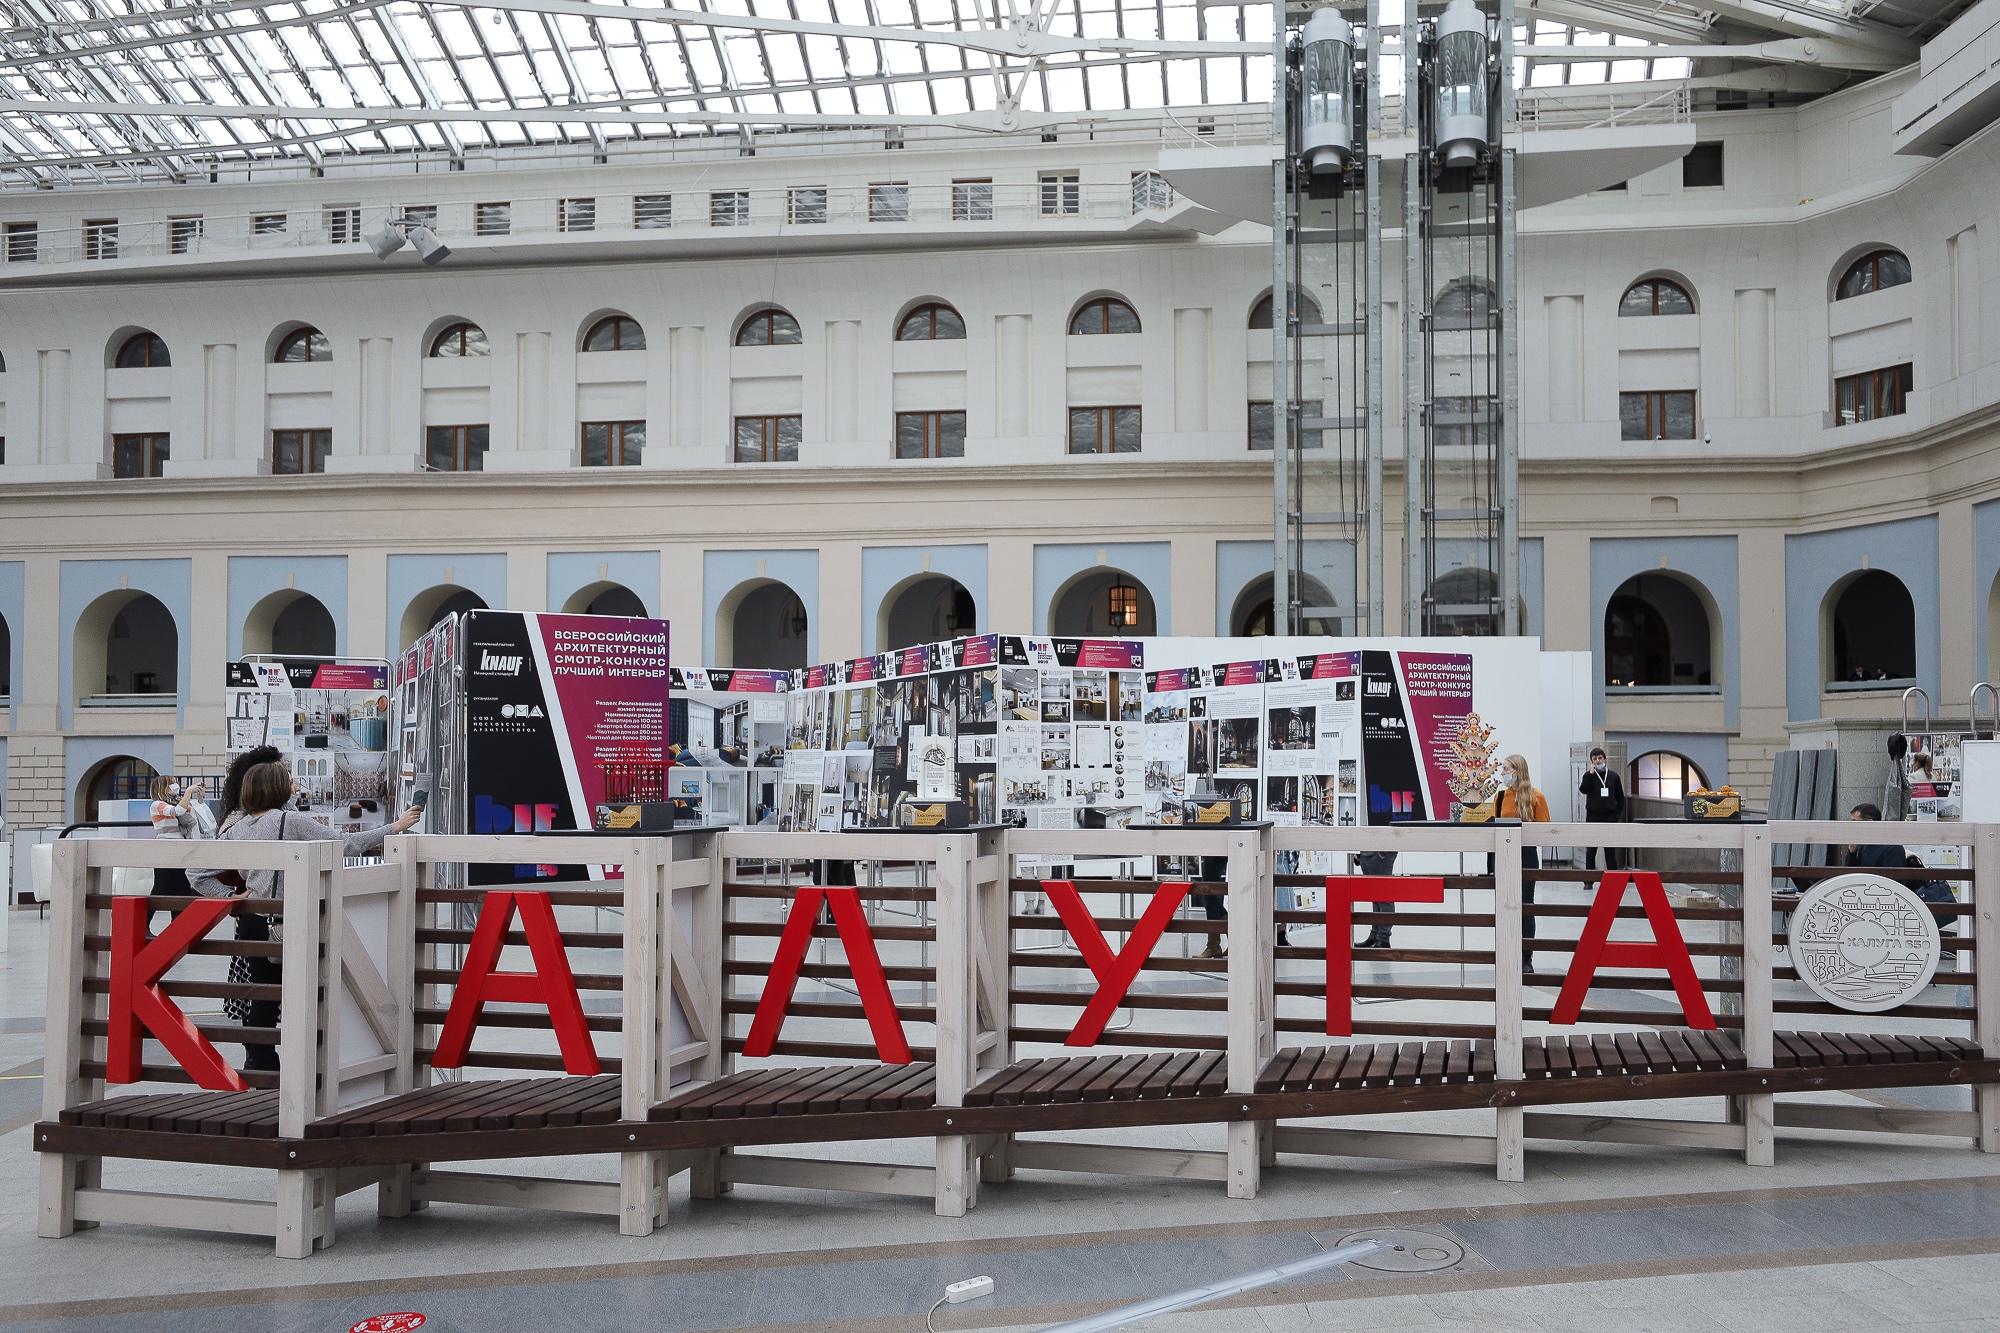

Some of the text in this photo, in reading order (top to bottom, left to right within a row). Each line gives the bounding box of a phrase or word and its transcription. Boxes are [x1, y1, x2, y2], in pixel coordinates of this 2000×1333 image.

[554, 630, 666, 643] ВСЕРОССИЙСКИЙ
[554, 643, 666, 655] АРХИТЕКТУРНЫЙ
[480, 649, 523, 676] KNAUF
[554, 655, 666, 667] СМОТР-КОНКУРС
[1408, 662, 1471, 672] ВСЕРОССИЙСКИЙ
[554, 666, 666, 678] ЛУЧШИЙ ИНТЕРЬЕР
[1408, 672, 1471, 681] АРХИТЕКТУРНЫЙ
[1367, 677, 1392, 697] KNAUF
[1408, 681, 1471, 689] СМОТР-КОНКУРС
[1409, 689, 1471, 698] ЛУЧШИЙ ИНТЕРЬЕР
[1847, 937, 1931, 950] КАЛУГА 650
[107, 871, 1716, 1091] КАЛУГА
